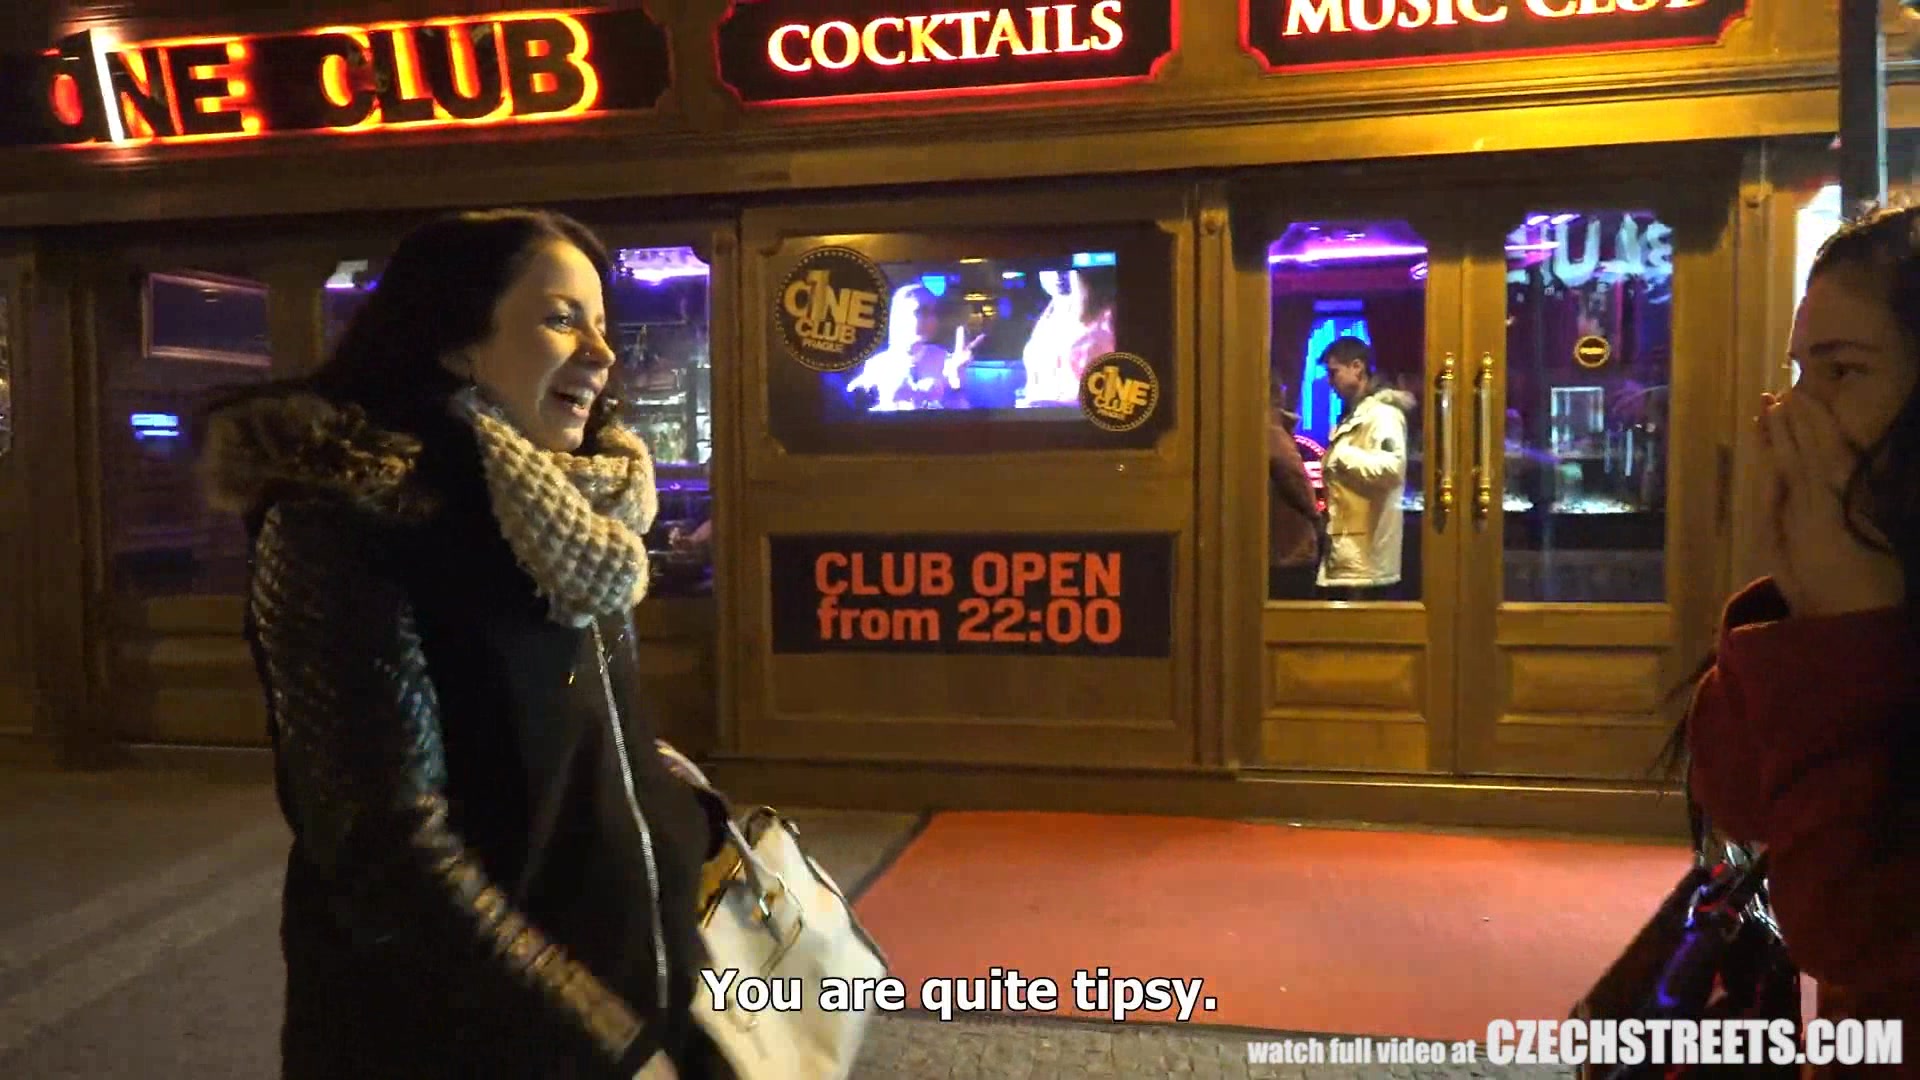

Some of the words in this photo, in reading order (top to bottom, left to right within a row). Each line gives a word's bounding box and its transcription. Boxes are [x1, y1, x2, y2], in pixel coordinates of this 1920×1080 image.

[767, 0, 1124, 72] COCKTAILS
[304, 15, 594, 128] CLUB
[795, 319, 857, 345] CLUB
[815, 552, 955, 597] CLUB
[972, 552, 1122, 597] OPEN
[818, 595, 940, 642] from
[957, 597, 1122, 644] 22:00
